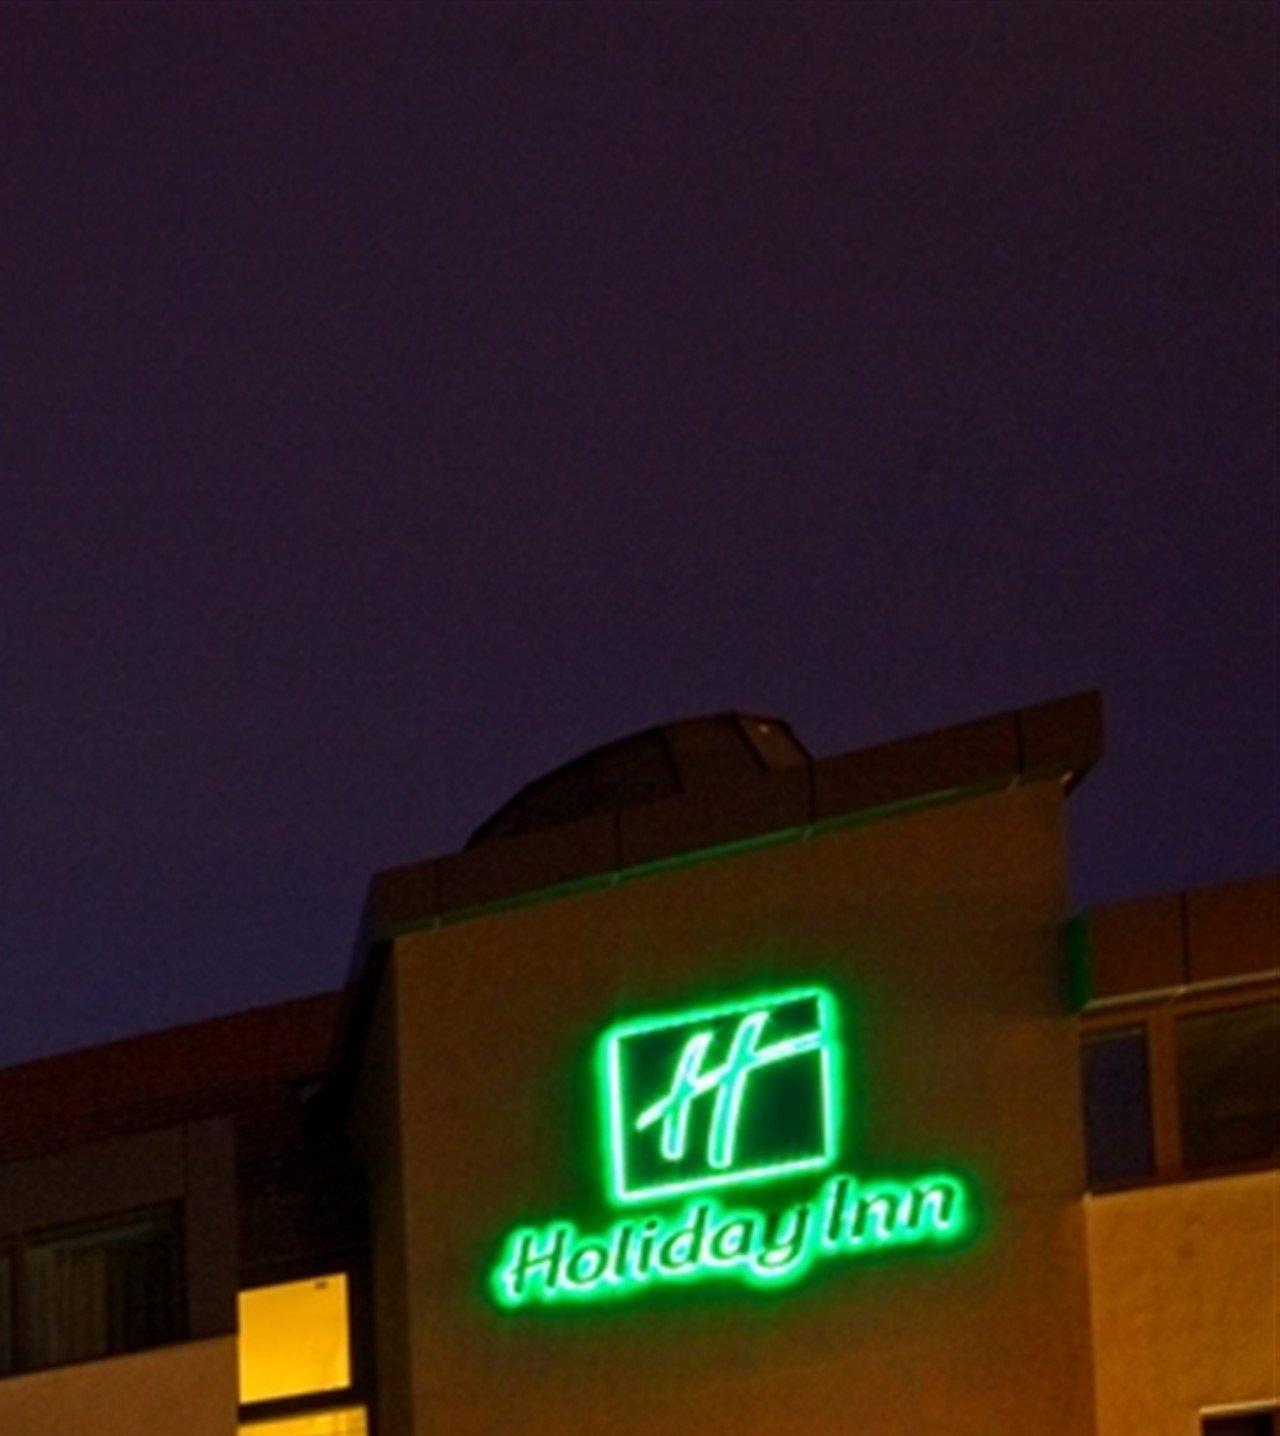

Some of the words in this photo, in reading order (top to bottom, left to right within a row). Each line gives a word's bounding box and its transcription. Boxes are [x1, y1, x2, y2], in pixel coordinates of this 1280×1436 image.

[634, 1008, 825, 1169] H
[500, 1203, 813, 1295] Holiday
[820, 1177, 960, 1243] Inn
